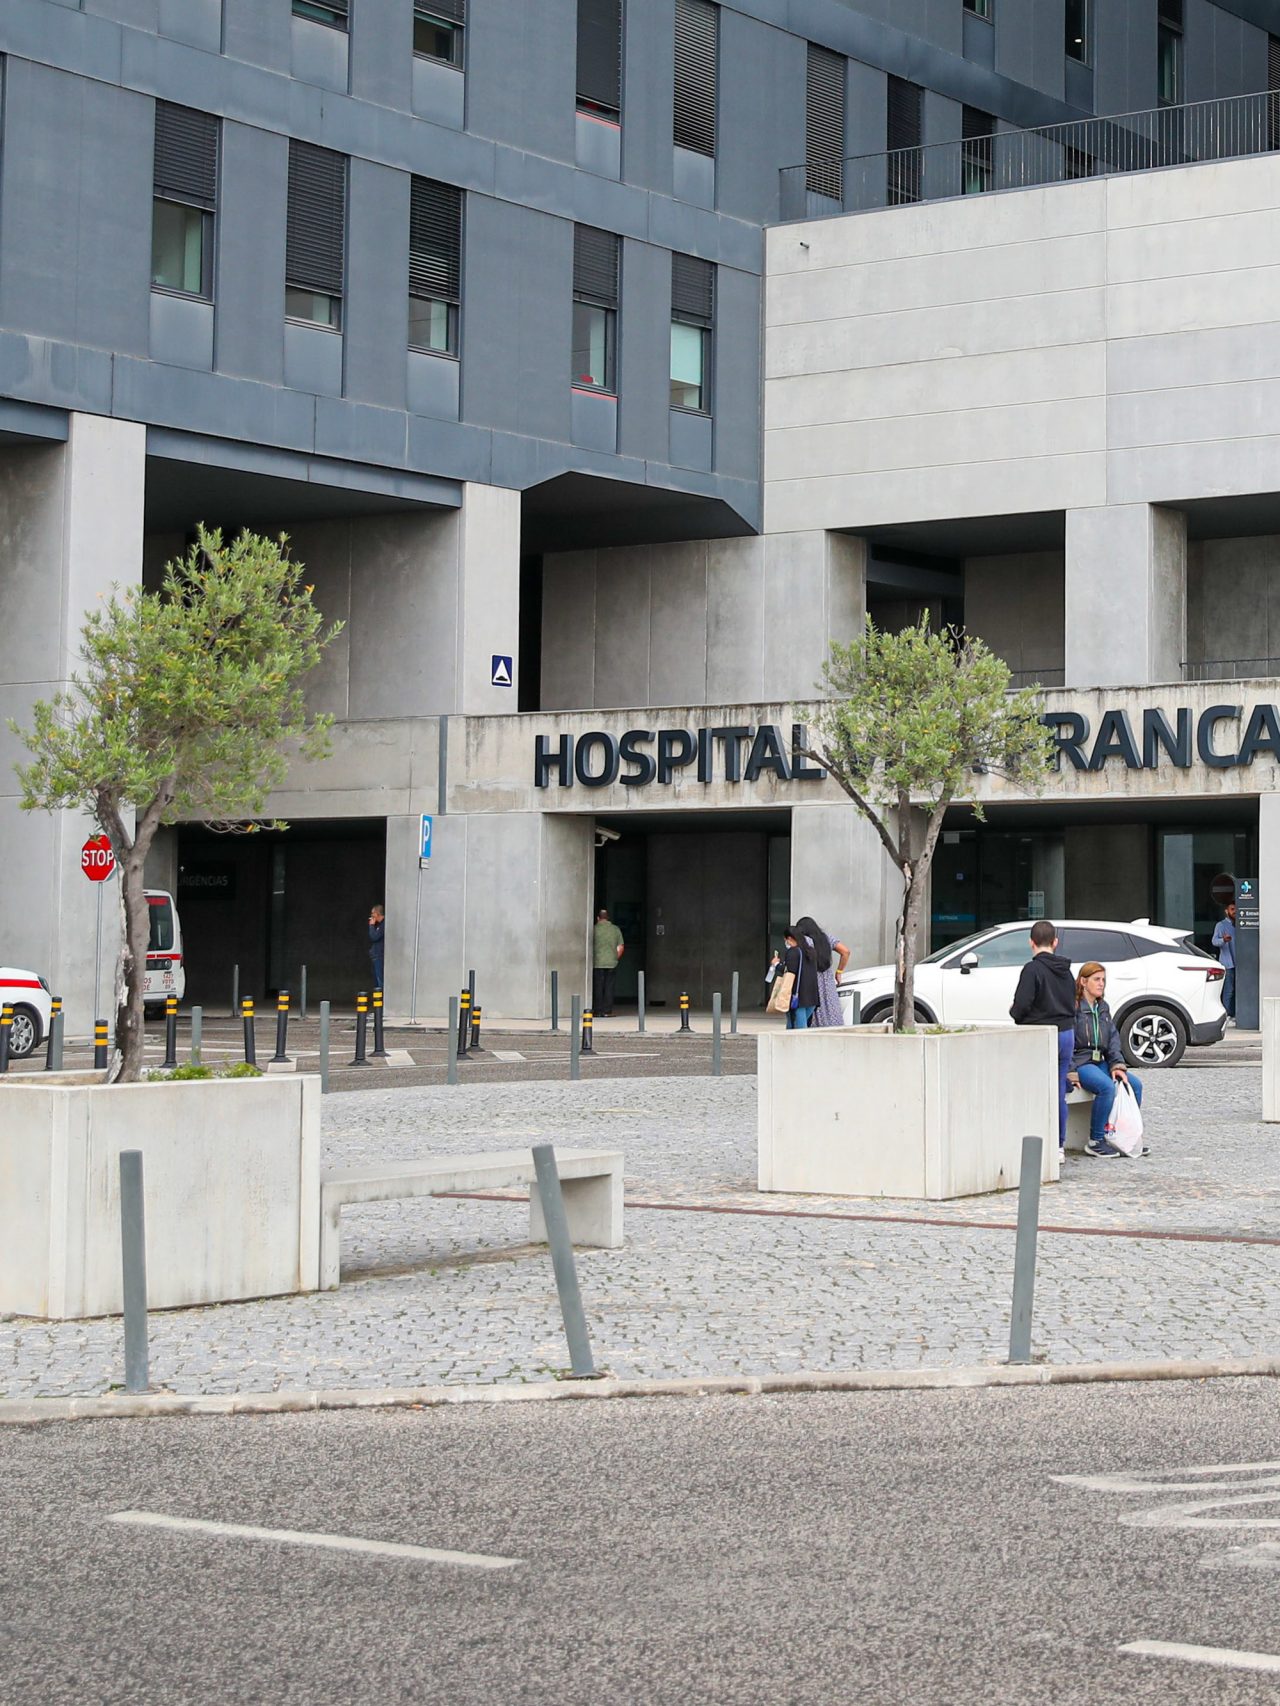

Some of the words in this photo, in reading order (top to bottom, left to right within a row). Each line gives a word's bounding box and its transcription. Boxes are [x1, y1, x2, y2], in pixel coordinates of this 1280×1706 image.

[534, 724, 827, 788] HOSPITAL
[423, 820, 430, 853] P
[82, 850, 114, 867] STOP
